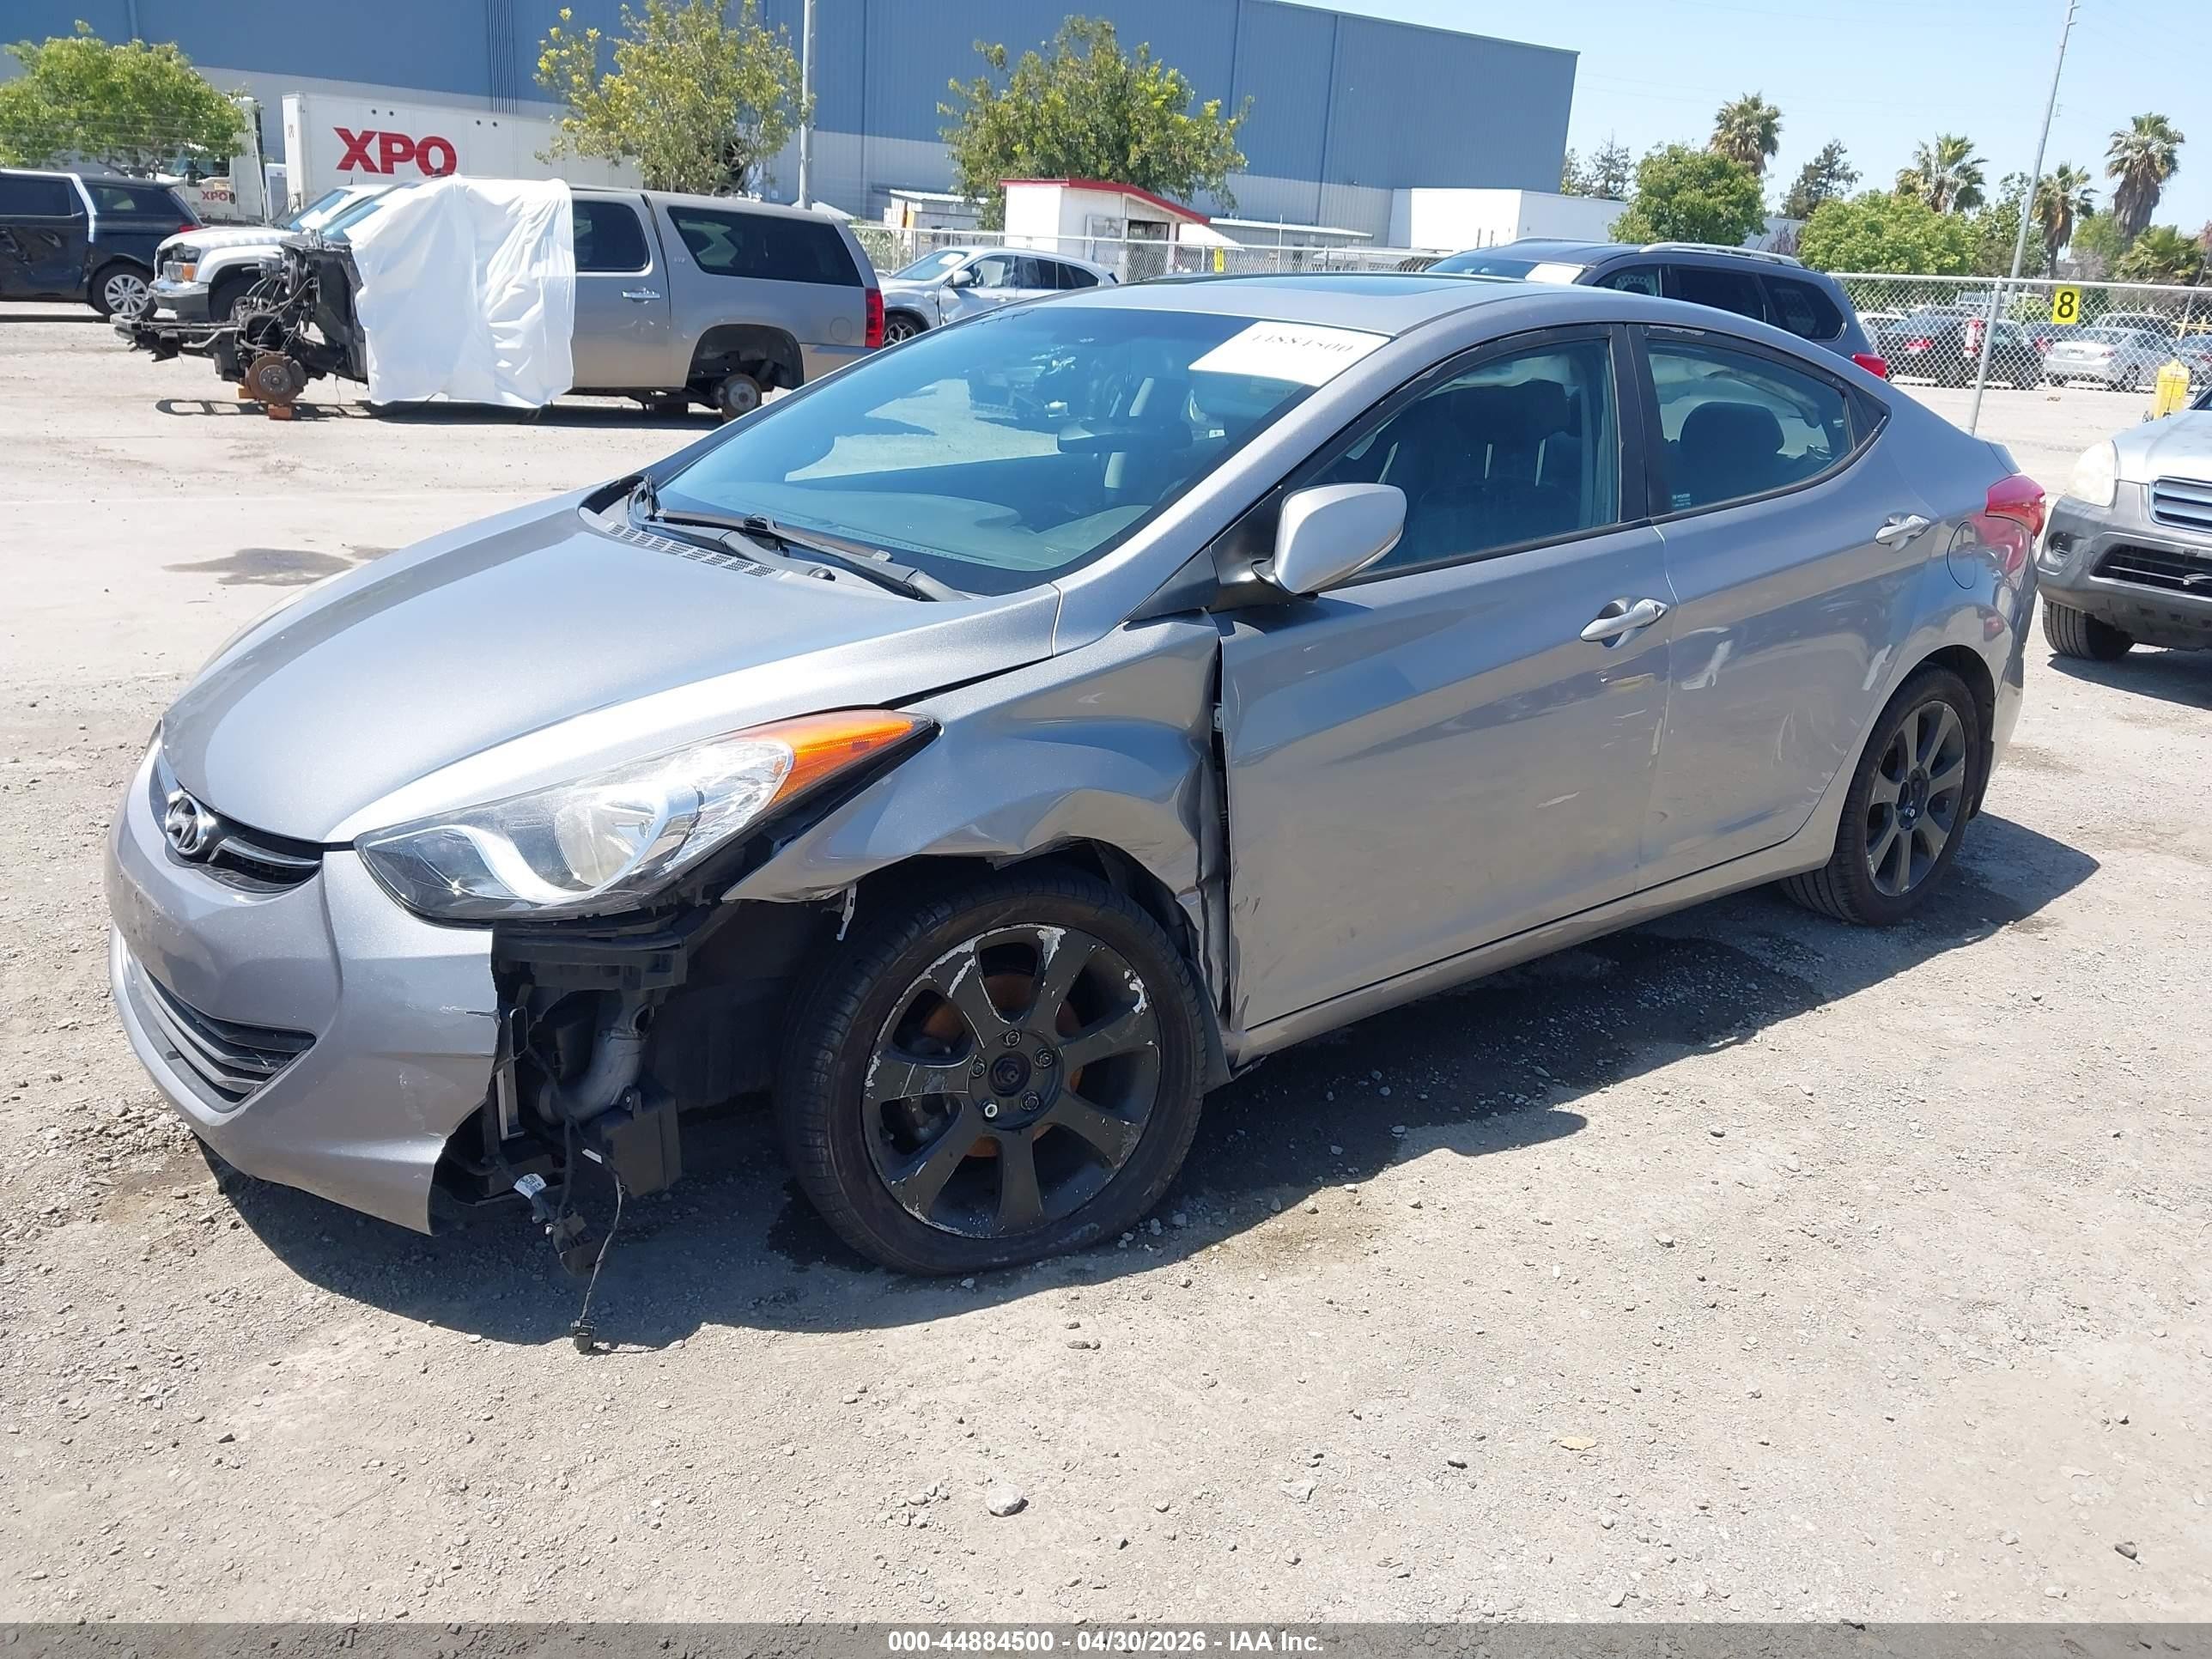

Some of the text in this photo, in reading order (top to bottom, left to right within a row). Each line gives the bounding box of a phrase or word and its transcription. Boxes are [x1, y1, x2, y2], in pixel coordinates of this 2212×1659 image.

[333, 126, 458, 178] XPO
[201, 190, 228, 201] XPO
[1216, 250, 1223, 268] 10
[2057, 291, 2075, 318] 8
